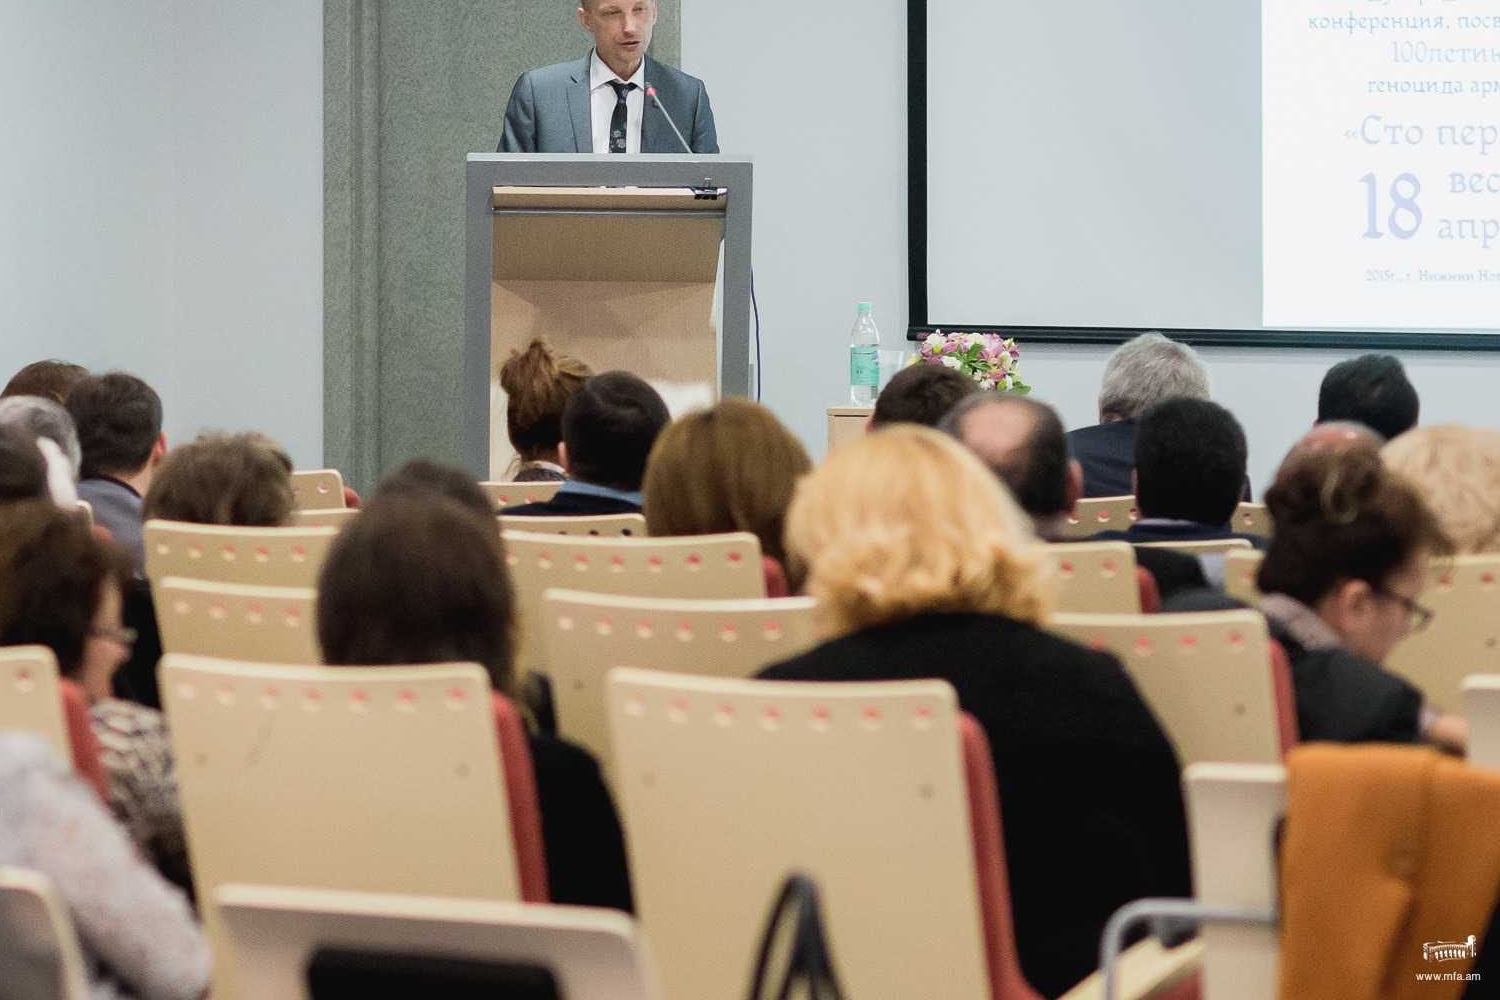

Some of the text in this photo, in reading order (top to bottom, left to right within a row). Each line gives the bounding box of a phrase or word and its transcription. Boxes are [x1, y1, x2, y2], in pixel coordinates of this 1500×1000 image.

[1308, 10, 1450, 35] конференция,
[1368, 80, 1463, 95] геноцида
[1344, 114, 1498, 156] «Сто пер
[1448, 172, 1500, 194] вес
[1359, 172, 1500, 249] 18 апр
